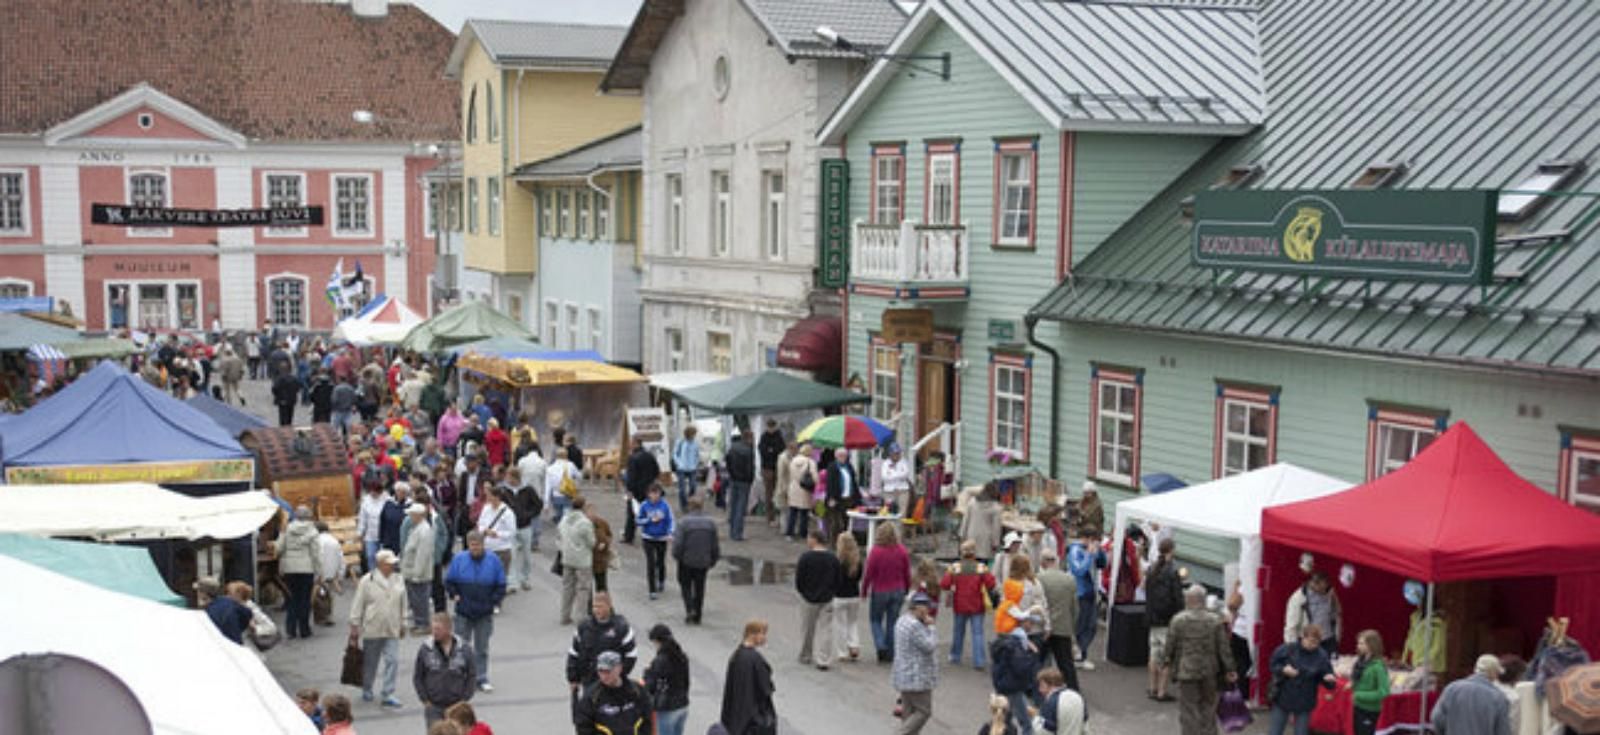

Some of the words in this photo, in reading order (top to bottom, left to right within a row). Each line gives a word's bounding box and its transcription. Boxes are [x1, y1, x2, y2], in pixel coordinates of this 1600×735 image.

[79, 152, 124, 161] ANNO
[129, 208, 209, 222] RAKVERE
[210, 210, 267, 222] TEATRI
[831, 167, 841, 279] RESTORAN
